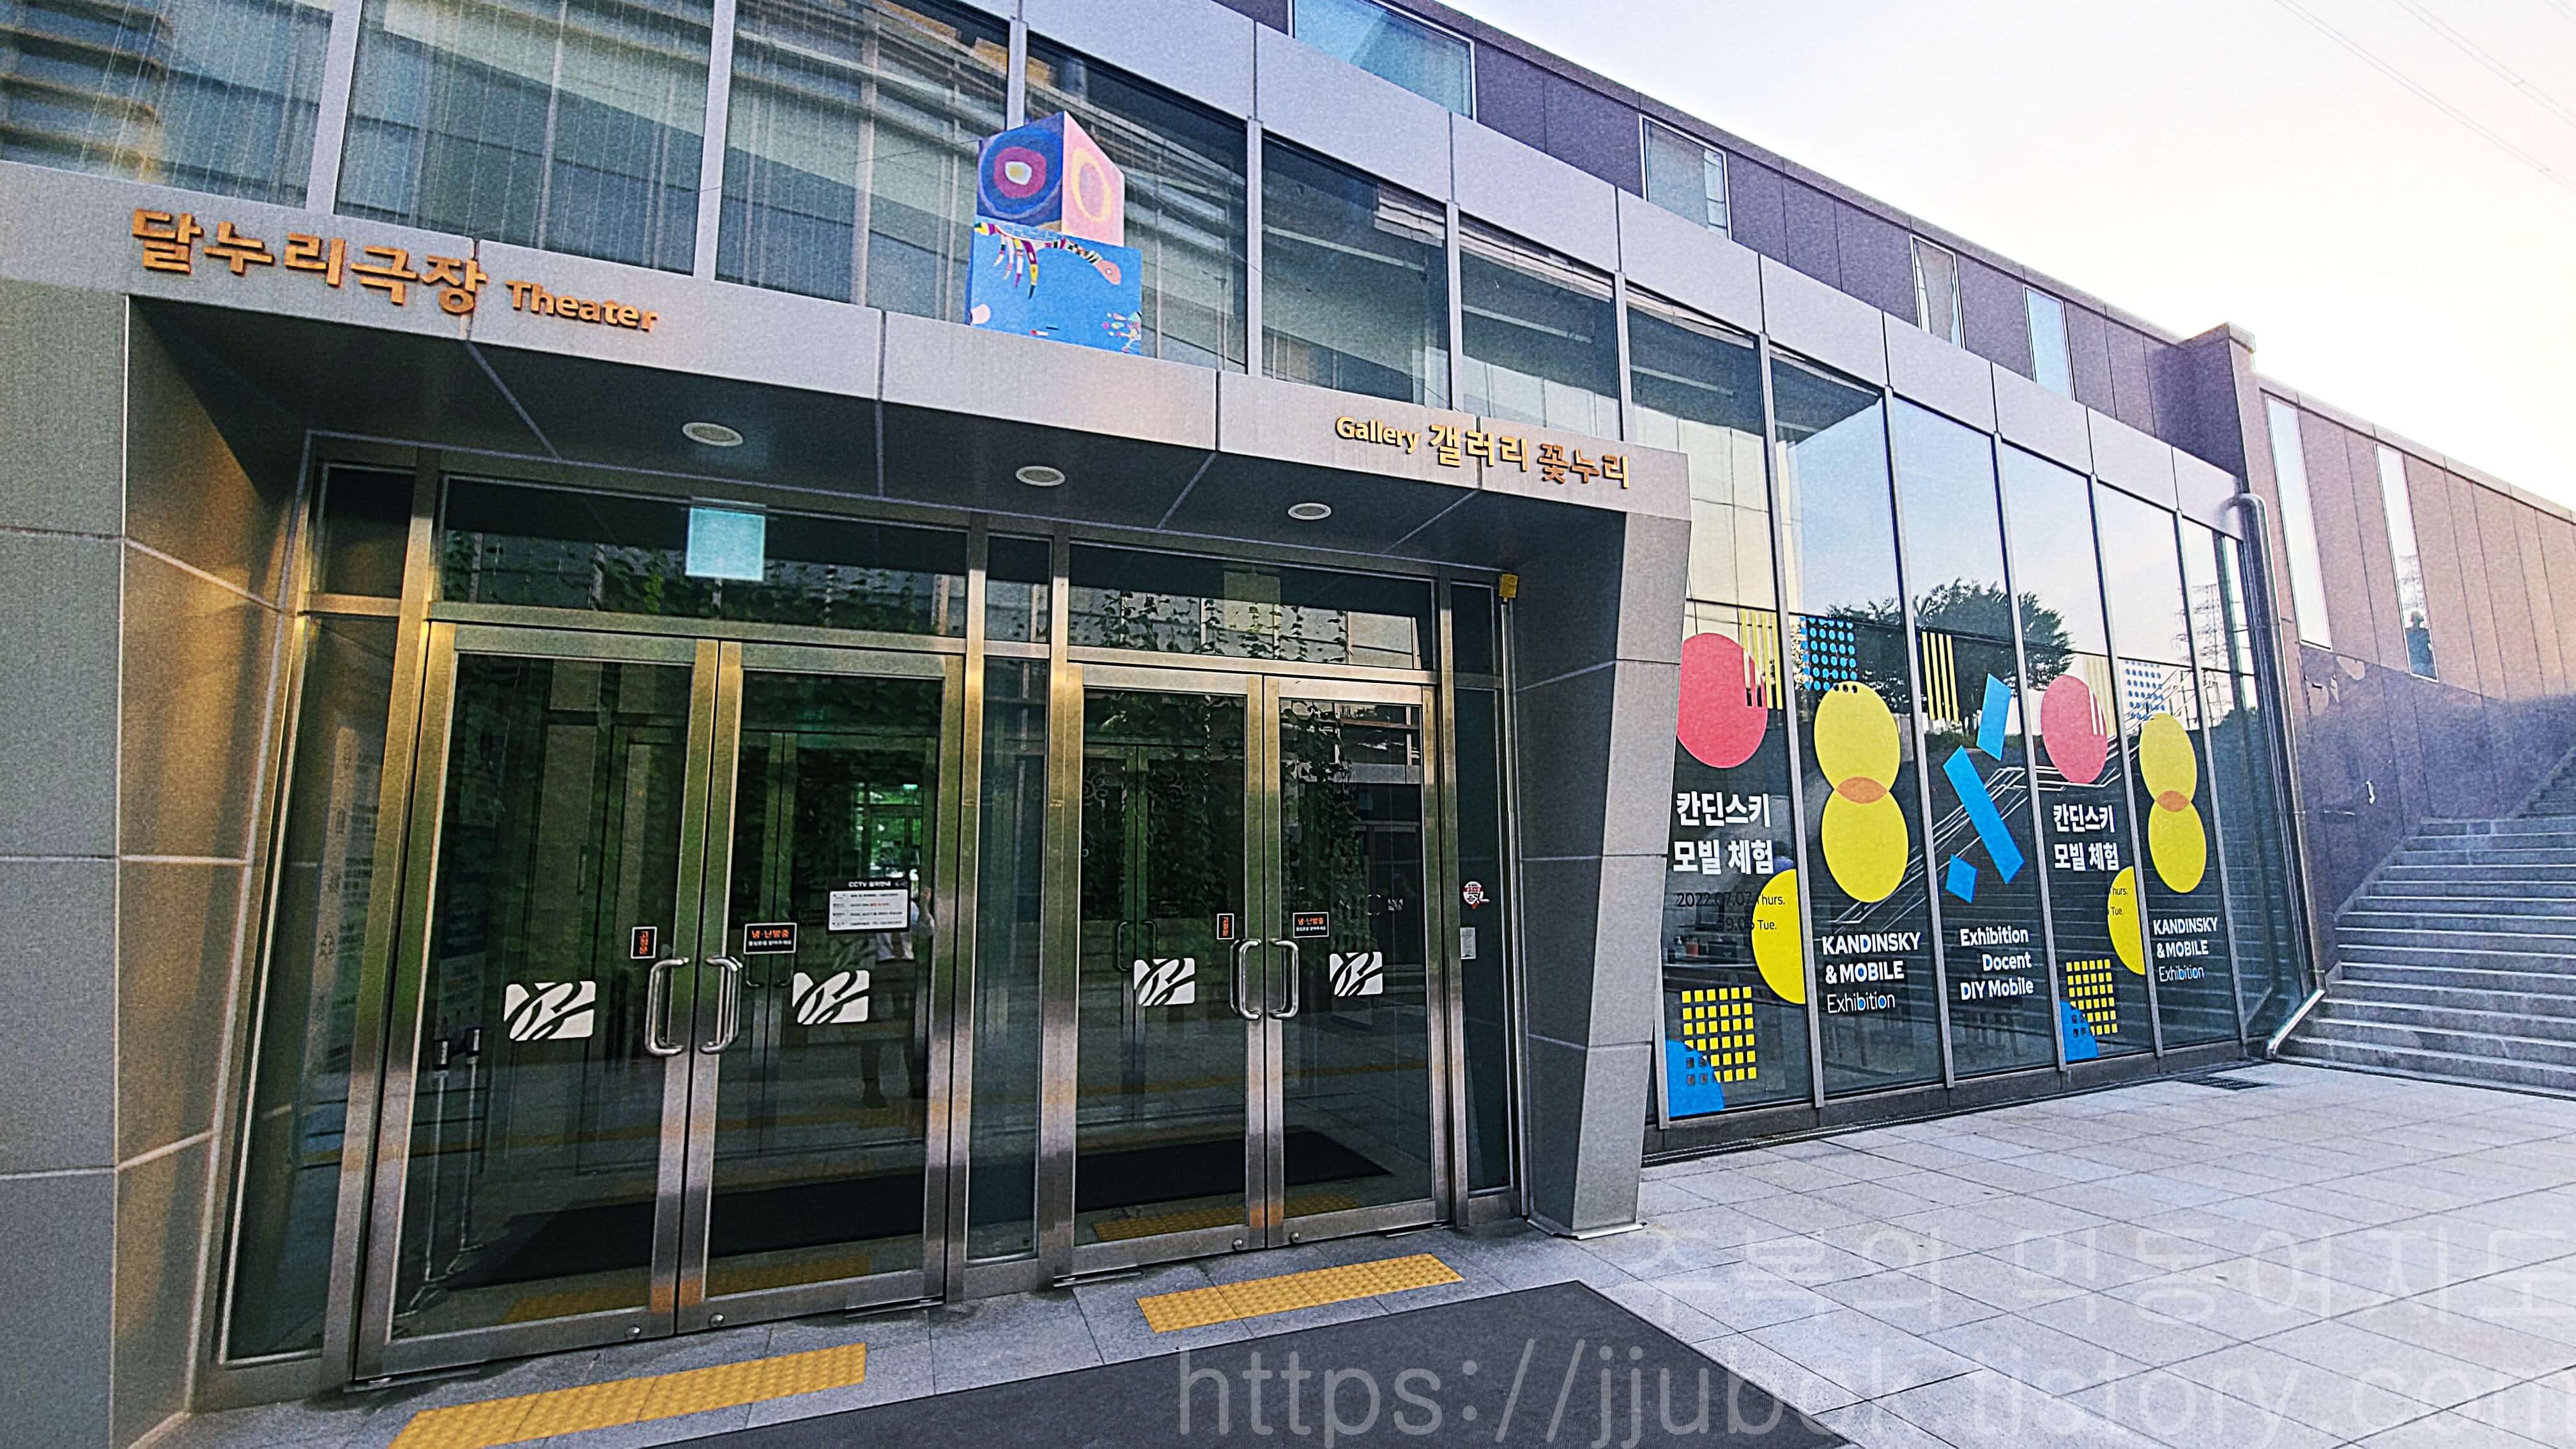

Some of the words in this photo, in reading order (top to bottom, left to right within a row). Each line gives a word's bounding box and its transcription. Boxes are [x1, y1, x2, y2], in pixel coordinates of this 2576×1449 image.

[132, 208, 487, 316] 달누리극장
[505, 279, 659, 331] Theater
[1336, 416, 1420, 454] Gallery
[1429, 424, 1528, 471] 갤러리
[1538, 443, 1630, 488] 꽃누리
[1676, 791, 1770, 827] 칸딘스키
[2053, 804, 2115, 832] 칸딘스키
[1673, 840, 1721, 875] 모빌
[1728, 839, 1774, 875] 체험
[2054, 843, 2085, 871] 모빌
[2088, 843, 2119, 871] 체험
[1758, 920, 1777, 930] Tue.
[2153, 917, 2218, 935] KANDINSKY
[1821, 931, 1920, 955] KANDINSKY
[1960, 928, 2029, 947] Exhibition
[1982, 951, 2032, 972] Docent
[2159, 965, 2204, 982] Exhibition
[1960, 980, 1986, 1000] DIY
[1988, 978, 2034, 997] Mobile
[1827, 992, 1896, 1014] Exhibition
